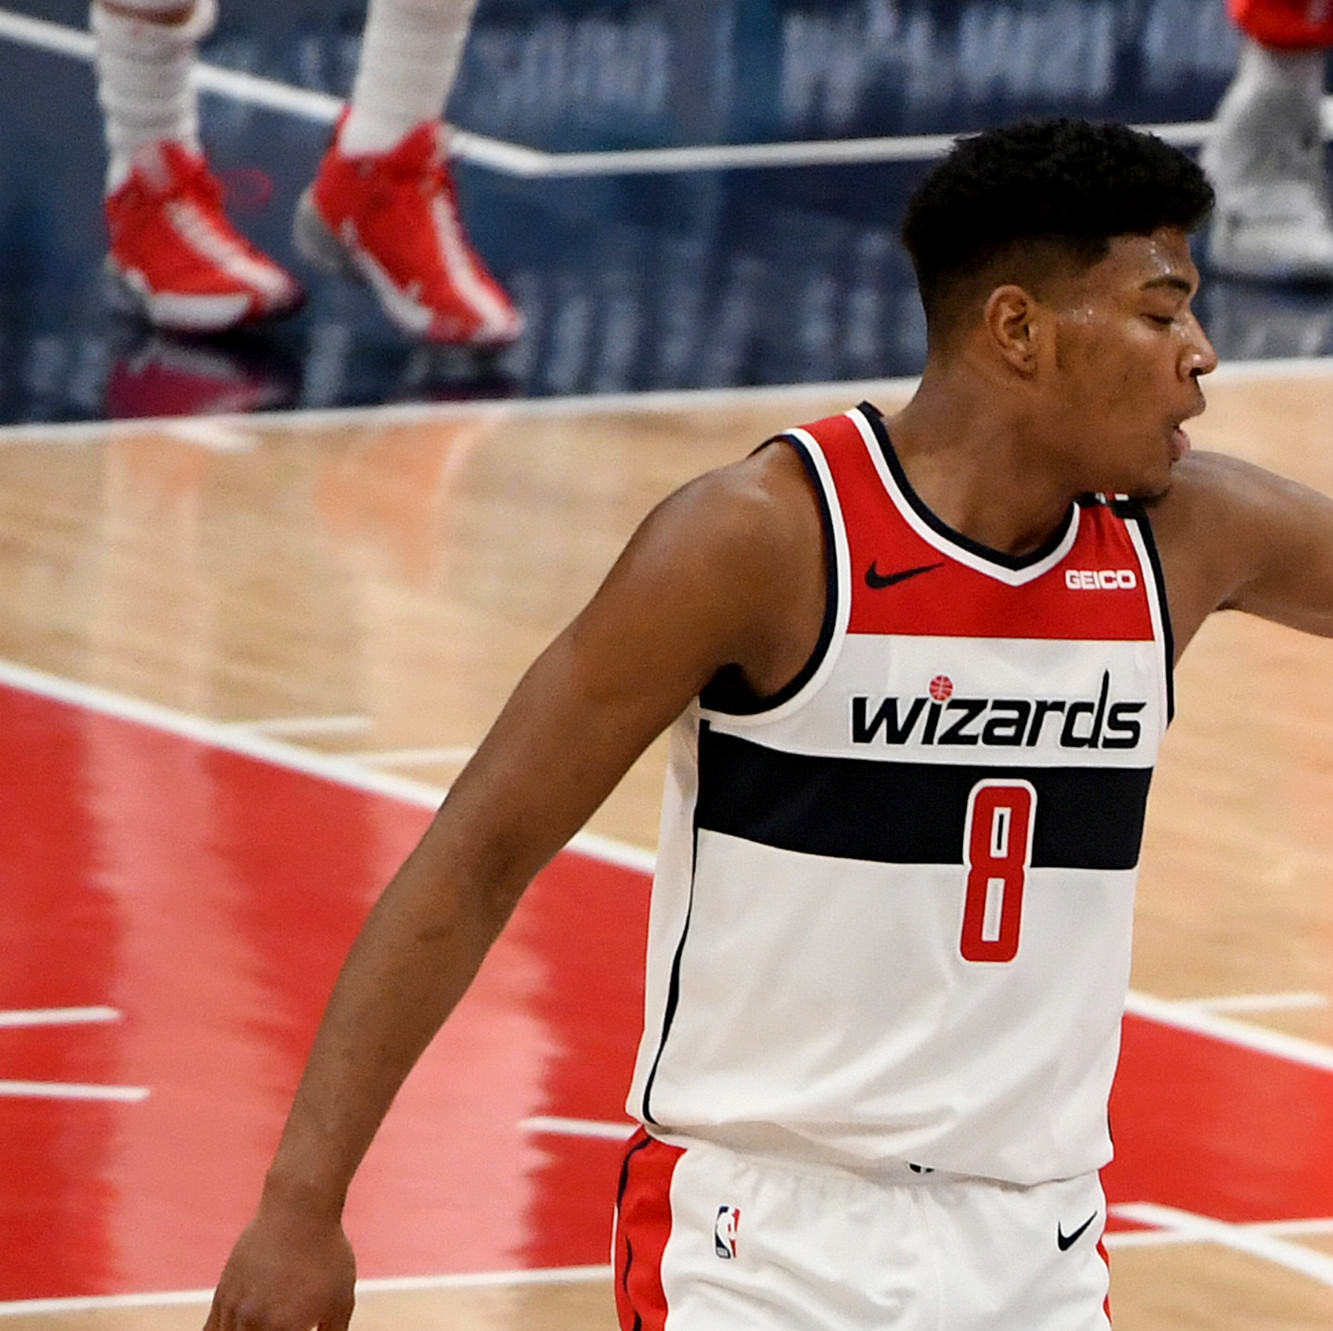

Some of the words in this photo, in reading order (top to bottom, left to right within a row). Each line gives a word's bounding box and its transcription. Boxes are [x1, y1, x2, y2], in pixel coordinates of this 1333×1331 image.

[1064, 569, 1137, 591] GEICO
[851, 669, 1147, 749] wizards
[959, 778, 1038, 964] 8
